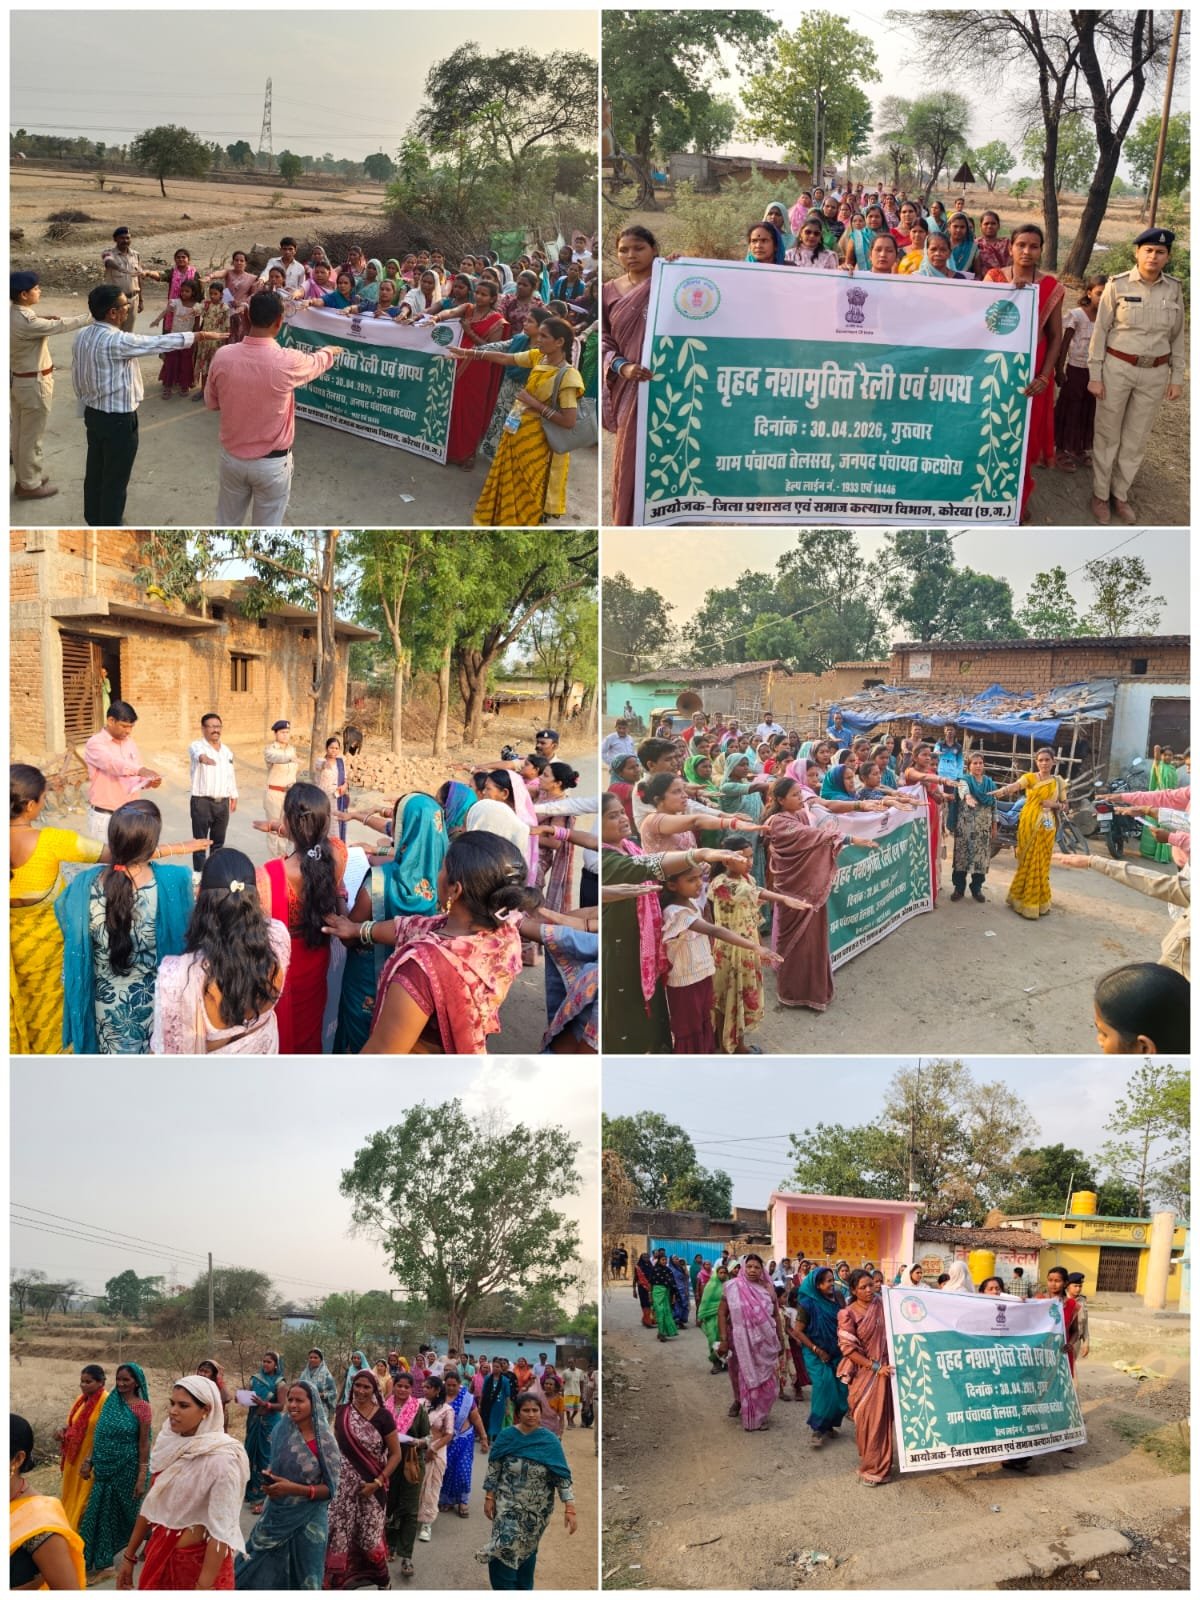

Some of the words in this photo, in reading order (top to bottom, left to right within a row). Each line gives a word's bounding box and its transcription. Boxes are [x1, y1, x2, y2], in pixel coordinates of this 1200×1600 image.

[358, 350, 379, 375] रैली
[381, 357, 397, 378] एवं
[398, 363, 424, 382] शपथ
[717, 366, 762, 407] वृहद
[765, 360, 857, 409] नशामुक्ति
[854, 362, 896, 400] रैली
[899, 366, 928, 400] एवं
[929, 374, 974, 404] शपथ
[754, 415, 799, 436] दिनांक
[810, 420, 888, 441] 30.04.2026,
[716, 455, 742, 471] ग्राम
[744, 449, 787, 471] पंचायत
[789, 448, 835, 472] तेलसरा,
[839, 453, 877, 470] जनपद
[879, 450, 919, 473] पंचायत
[920, 454, 964, 476] कटघोरा
[784, 478, 801, 492] हेल्प
[802, 478, 825, 493] लाईन
[841, 482, 859, 493] 1933
[860, 480, 873, 494] एवं
[746, 502, 792, 512] प्रशासन
[795, 498, 813, 514] एवं
[814, 502, 848, 513] समाज
[849, 502, 893, 514] कल्याण
[938, 502, 973, 517] कोरबा
[975, 504, 1012, 518] (छ.ग.)
[935, 1350, 963, 1379] वृहद
[964, 1343, 1016, 1375] नशामुक्ति
[965, 1382, 992, 1398] दिनांक
[946, 1411, 964, 1424] ग्राम
[965, 1406, 992, 1422] पंचायत
